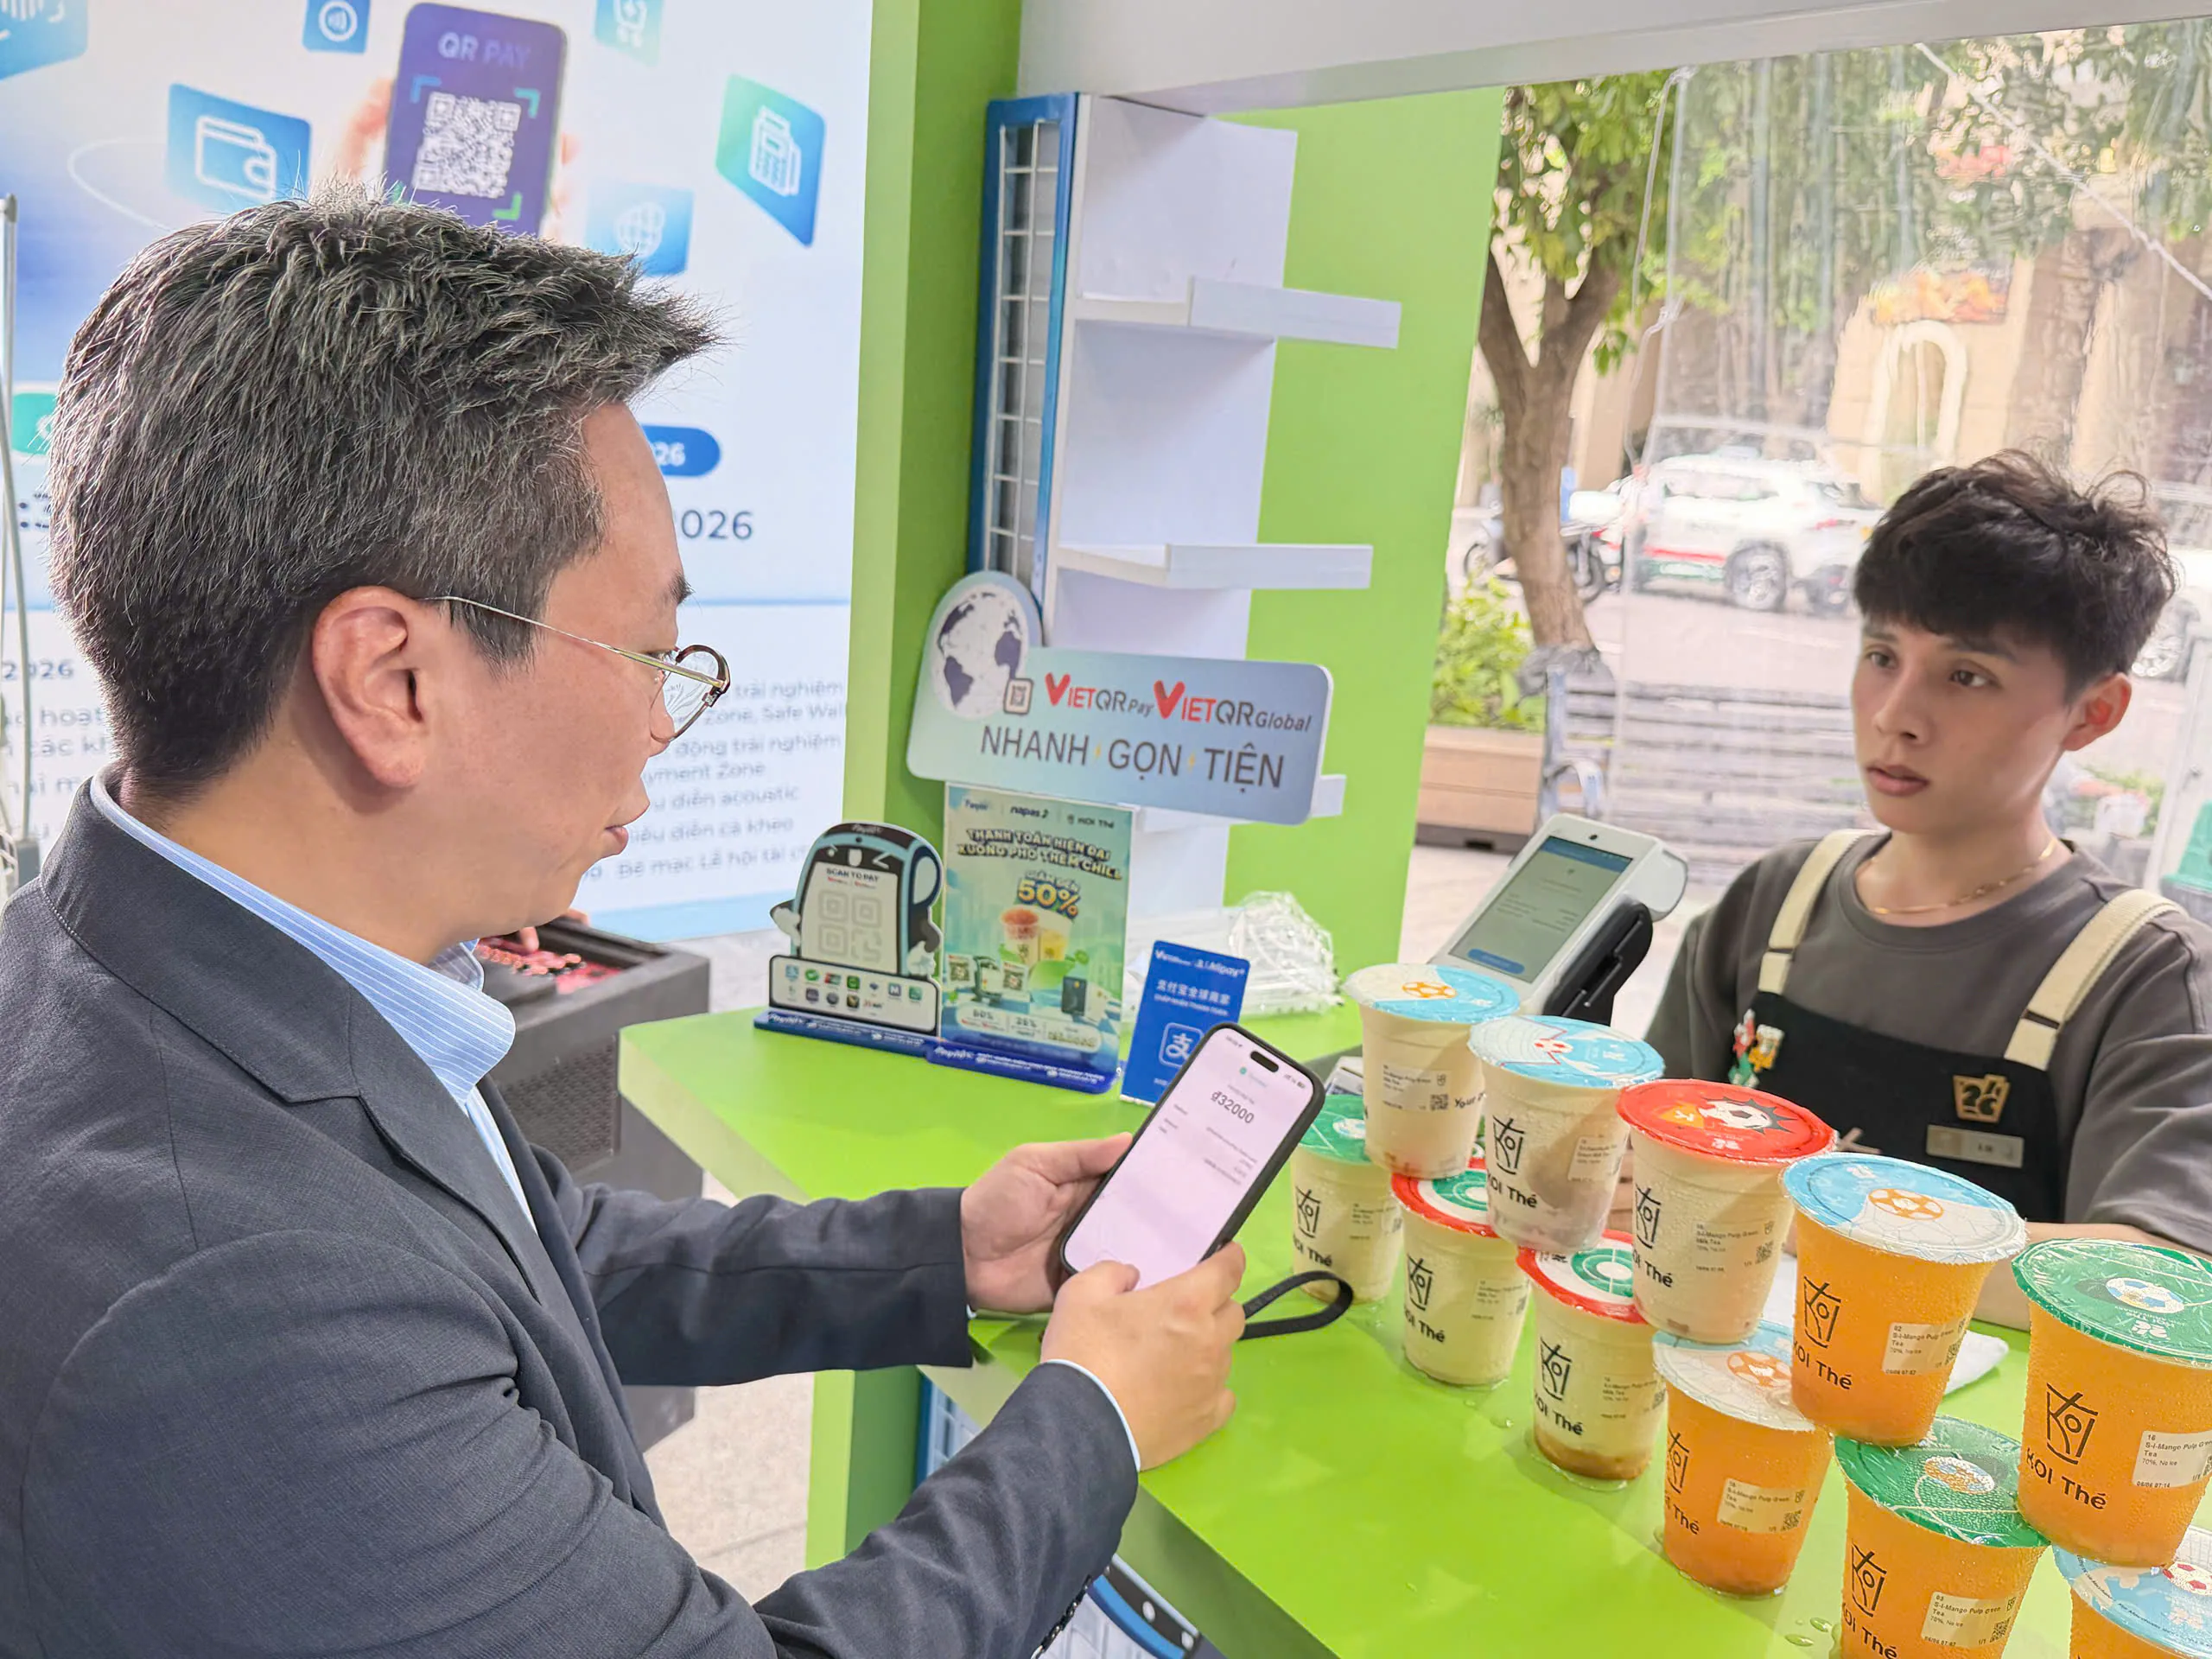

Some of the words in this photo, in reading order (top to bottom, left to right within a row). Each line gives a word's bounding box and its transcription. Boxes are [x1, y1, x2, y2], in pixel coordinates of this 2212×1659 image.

[437, 32, 479, 60] QR
[482, 39, 531, 69] PAY
[680, 510, 753, 540] 026
[980, 725, 1089, 766] NHANH
[1108, 739, 1183, 779] GỌN
[1204, 742, 1285, 794] TIỆN
[1018, 878, 1081, 918] 50%
[1506, 1185, 1537, 1208] Thé
[1306, 1246, 1332, 1268] Thé
[1644, 1260, 1673, 1287] Thé
[1418, 1319, 1445, 1343] Thé
[1815, 1360, 1853, 1390] Thé
[1552, 1409, 1583, 1435] Thé
[2026, 1447, 2053, 1484] KOI
[2061, 1476, 2107, 1510] Thé
[1673, 1503, 1700, 1535] Thé
[1932, 1608, 1945, 1617] Tea
[1861, 1626, 1897, 1659] Thé
